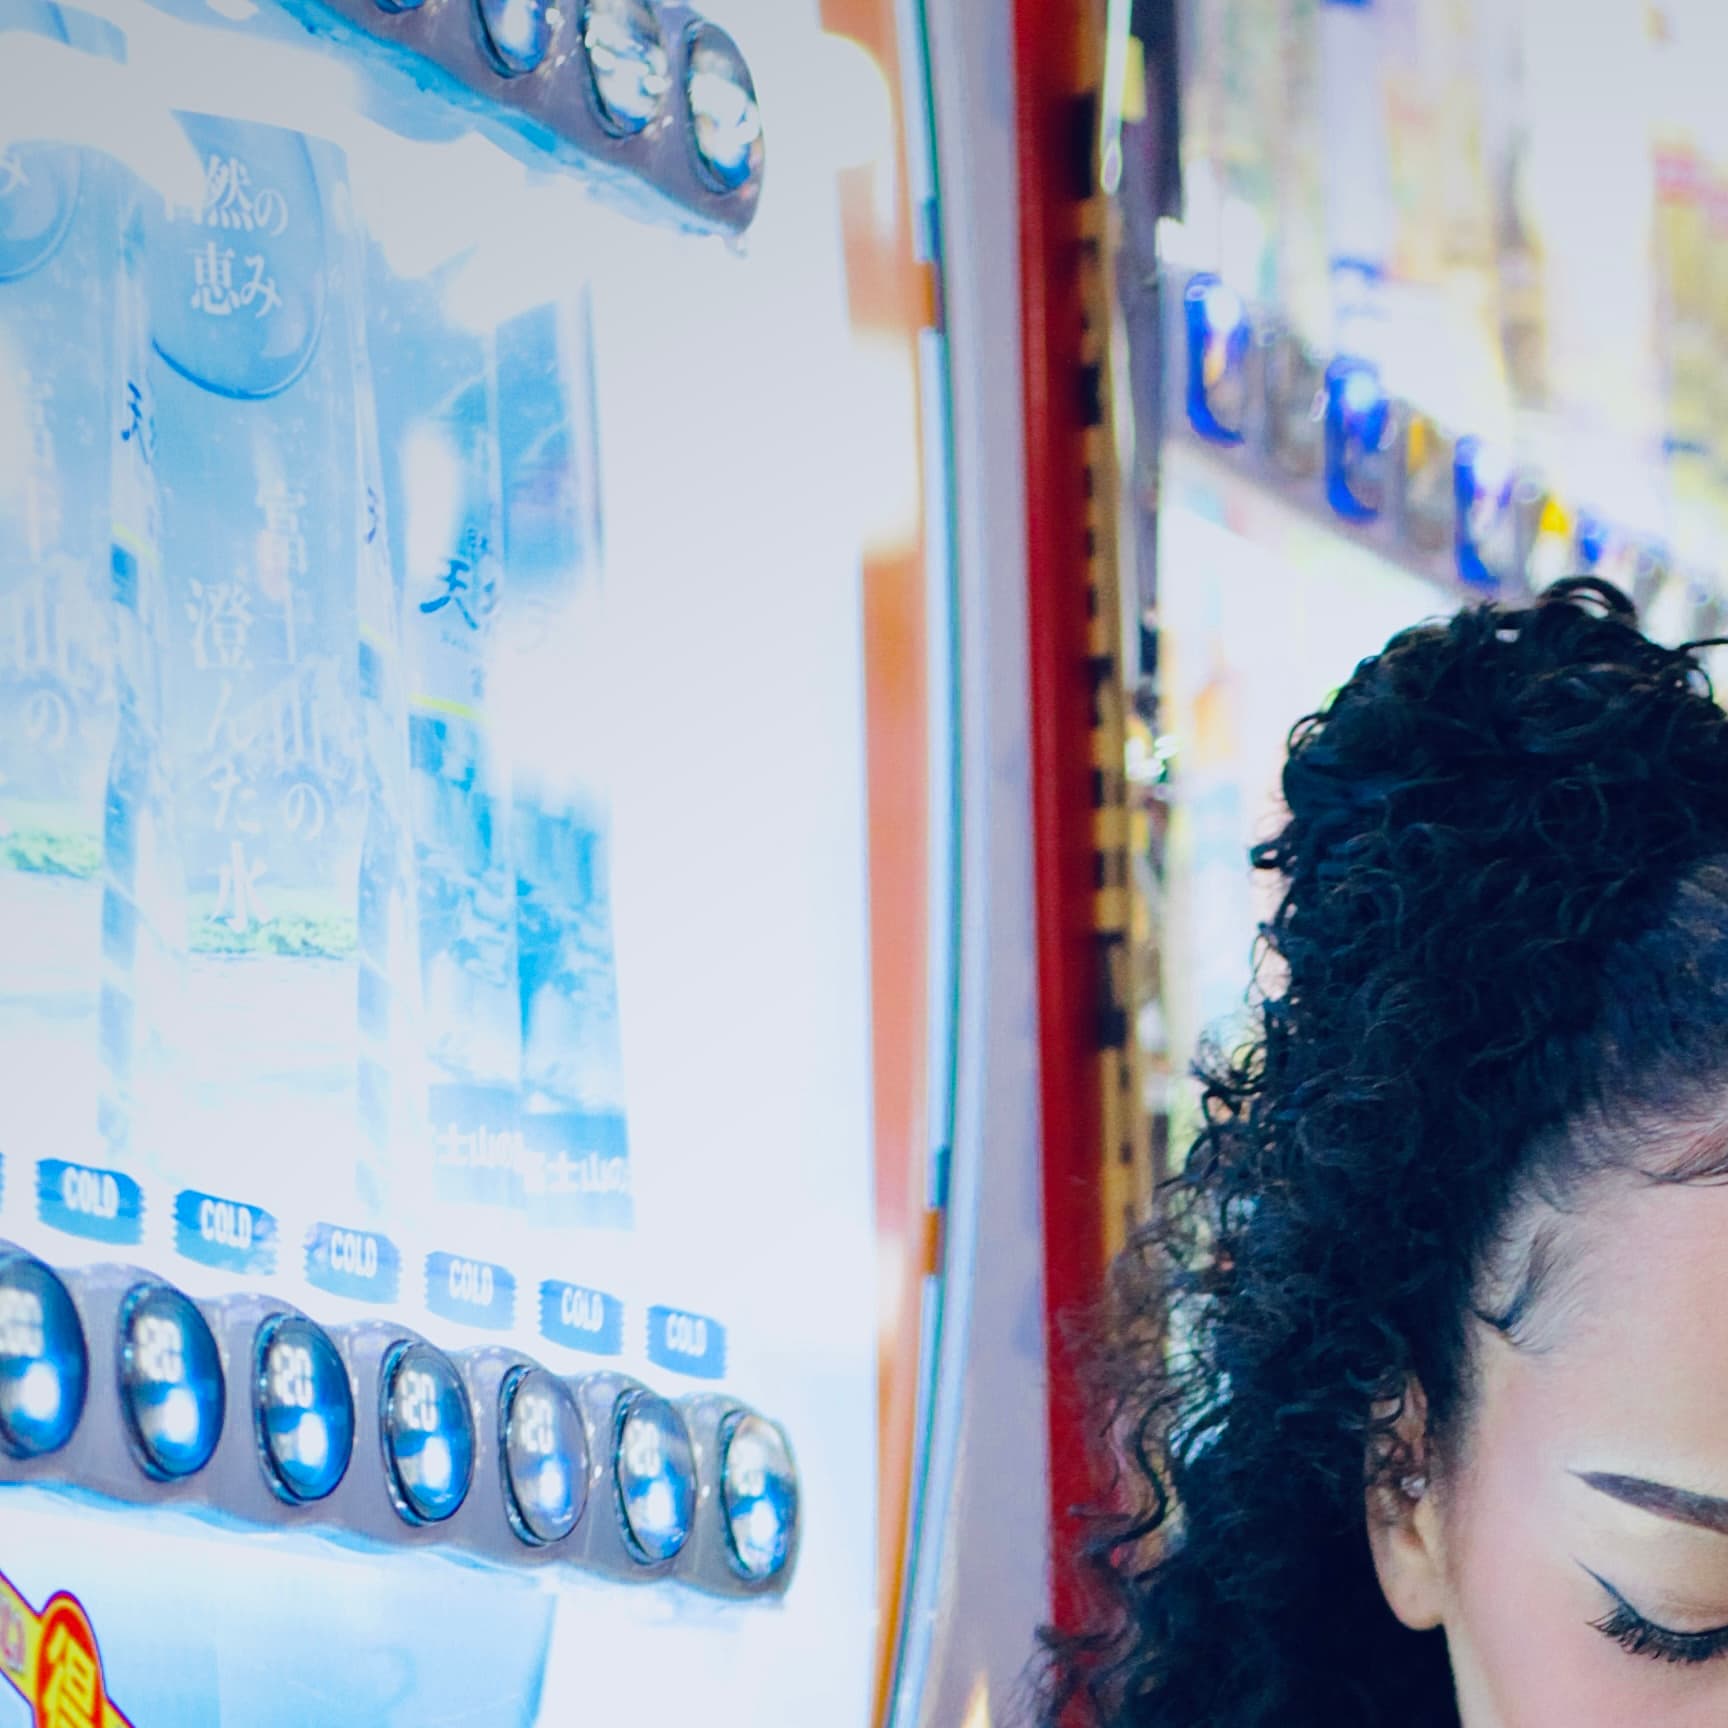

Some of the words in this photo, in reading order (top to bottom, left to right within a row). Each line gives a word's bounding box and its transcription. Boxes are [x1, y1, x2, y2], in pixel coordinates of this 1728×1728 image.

[165, 154, 289, 238] 然の
[188, 240, 283, 317] 恵み
[62, 1166, 120, 1219] COLD
[201, 1199, 251, 1249] COLD
[331, 1231, 376, 1278] COLD
[450, 1260, 494, 1306] COLD
[562, 1287, 604, 1331] COLD
[666, 1313, 707, 1356] COLD
